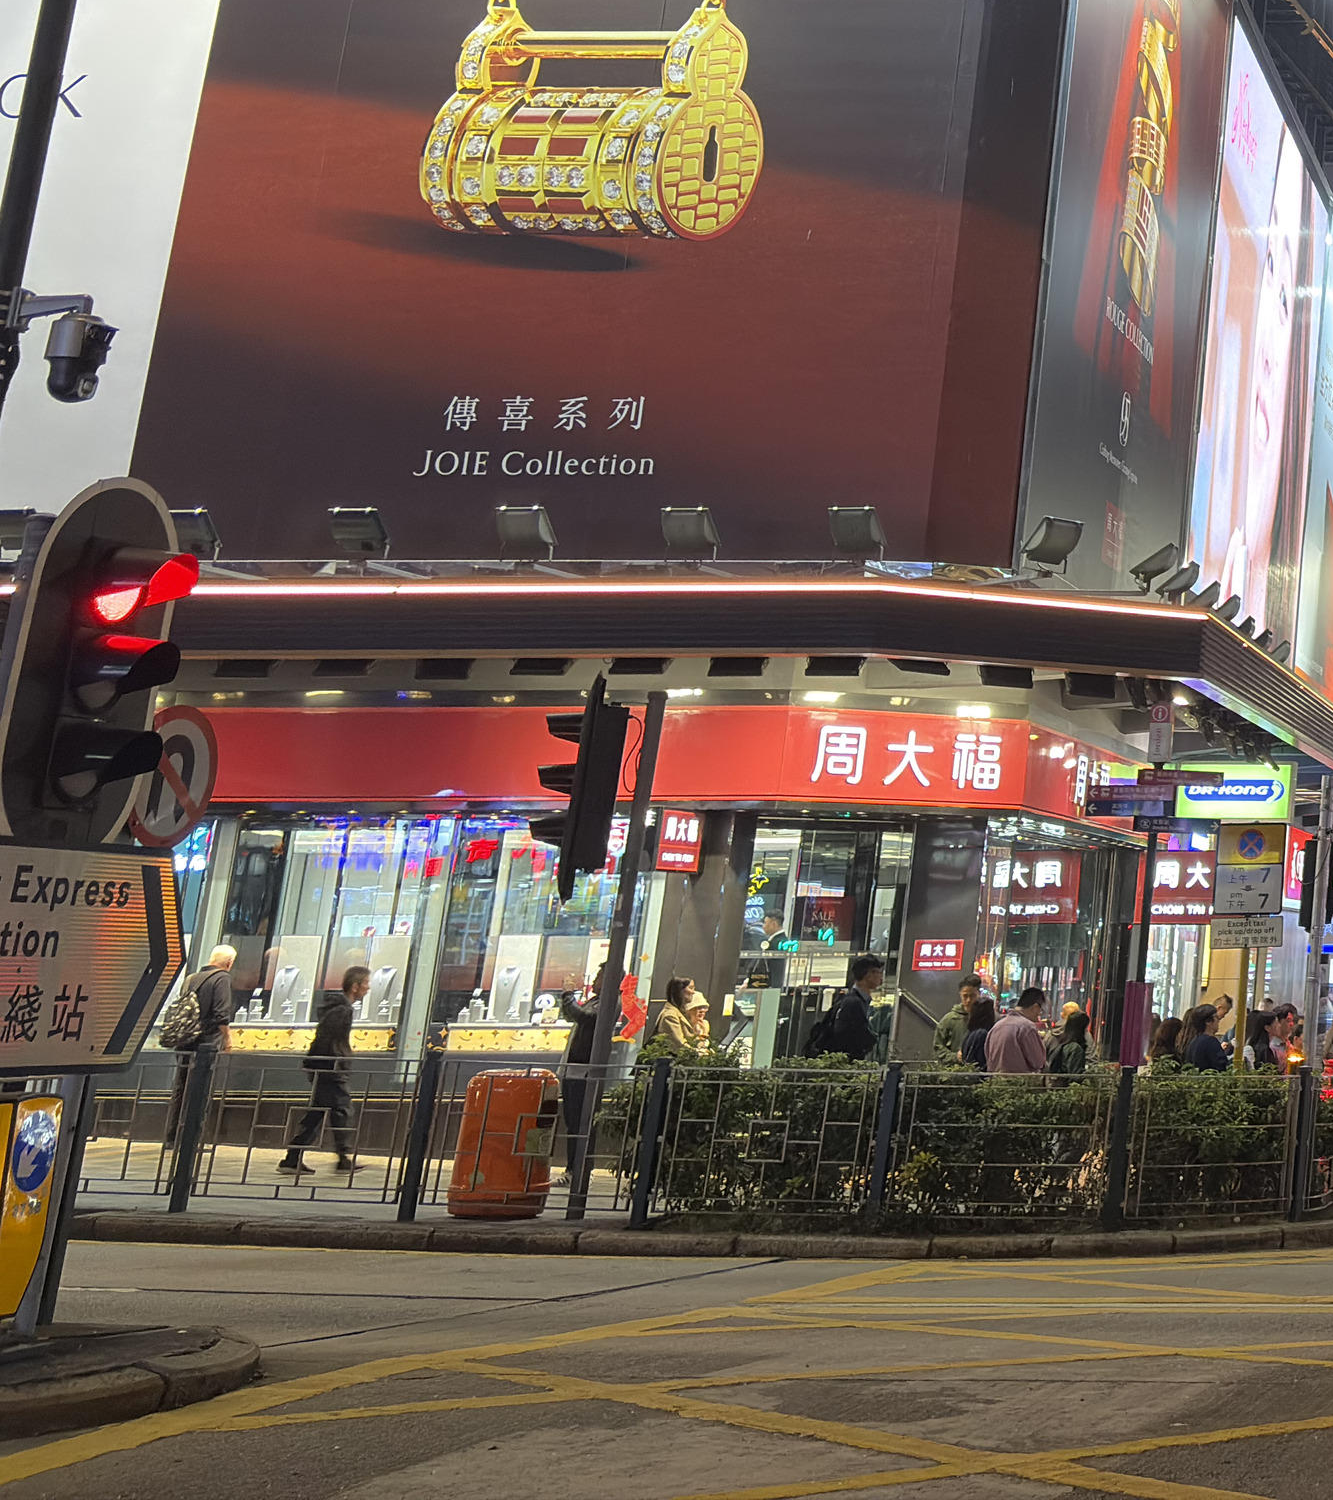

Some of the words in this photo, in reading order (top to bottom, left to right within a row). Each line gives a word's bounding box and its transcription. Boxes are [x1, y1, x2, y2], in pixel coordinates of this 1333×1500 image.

[1106, 297, 1125, 334] ROUGE
[1125, 318, 1154, 366] COLLECTION
[443, 394, 646, 432] 傳喜系列
[412, 450, 490, 478] JOIE
[501, 450, 656, 477] Collection
[810, 724, 1002, 791] 周大福
[1153, 860, 1212, 889] 周大
[1227, 874, 1249, 884] 上午
[1260, 867, 1271, 884] 7
[10, 864, 132, 912] Express
[1150, 904, 1185, 915] CHOW
[1226, 900, 1246, 910] 下午
[1258, 893, 1270, 910] 7
[1253, 919, 1267, 927] taxi
[1218, 929, 1233, 937] pick
